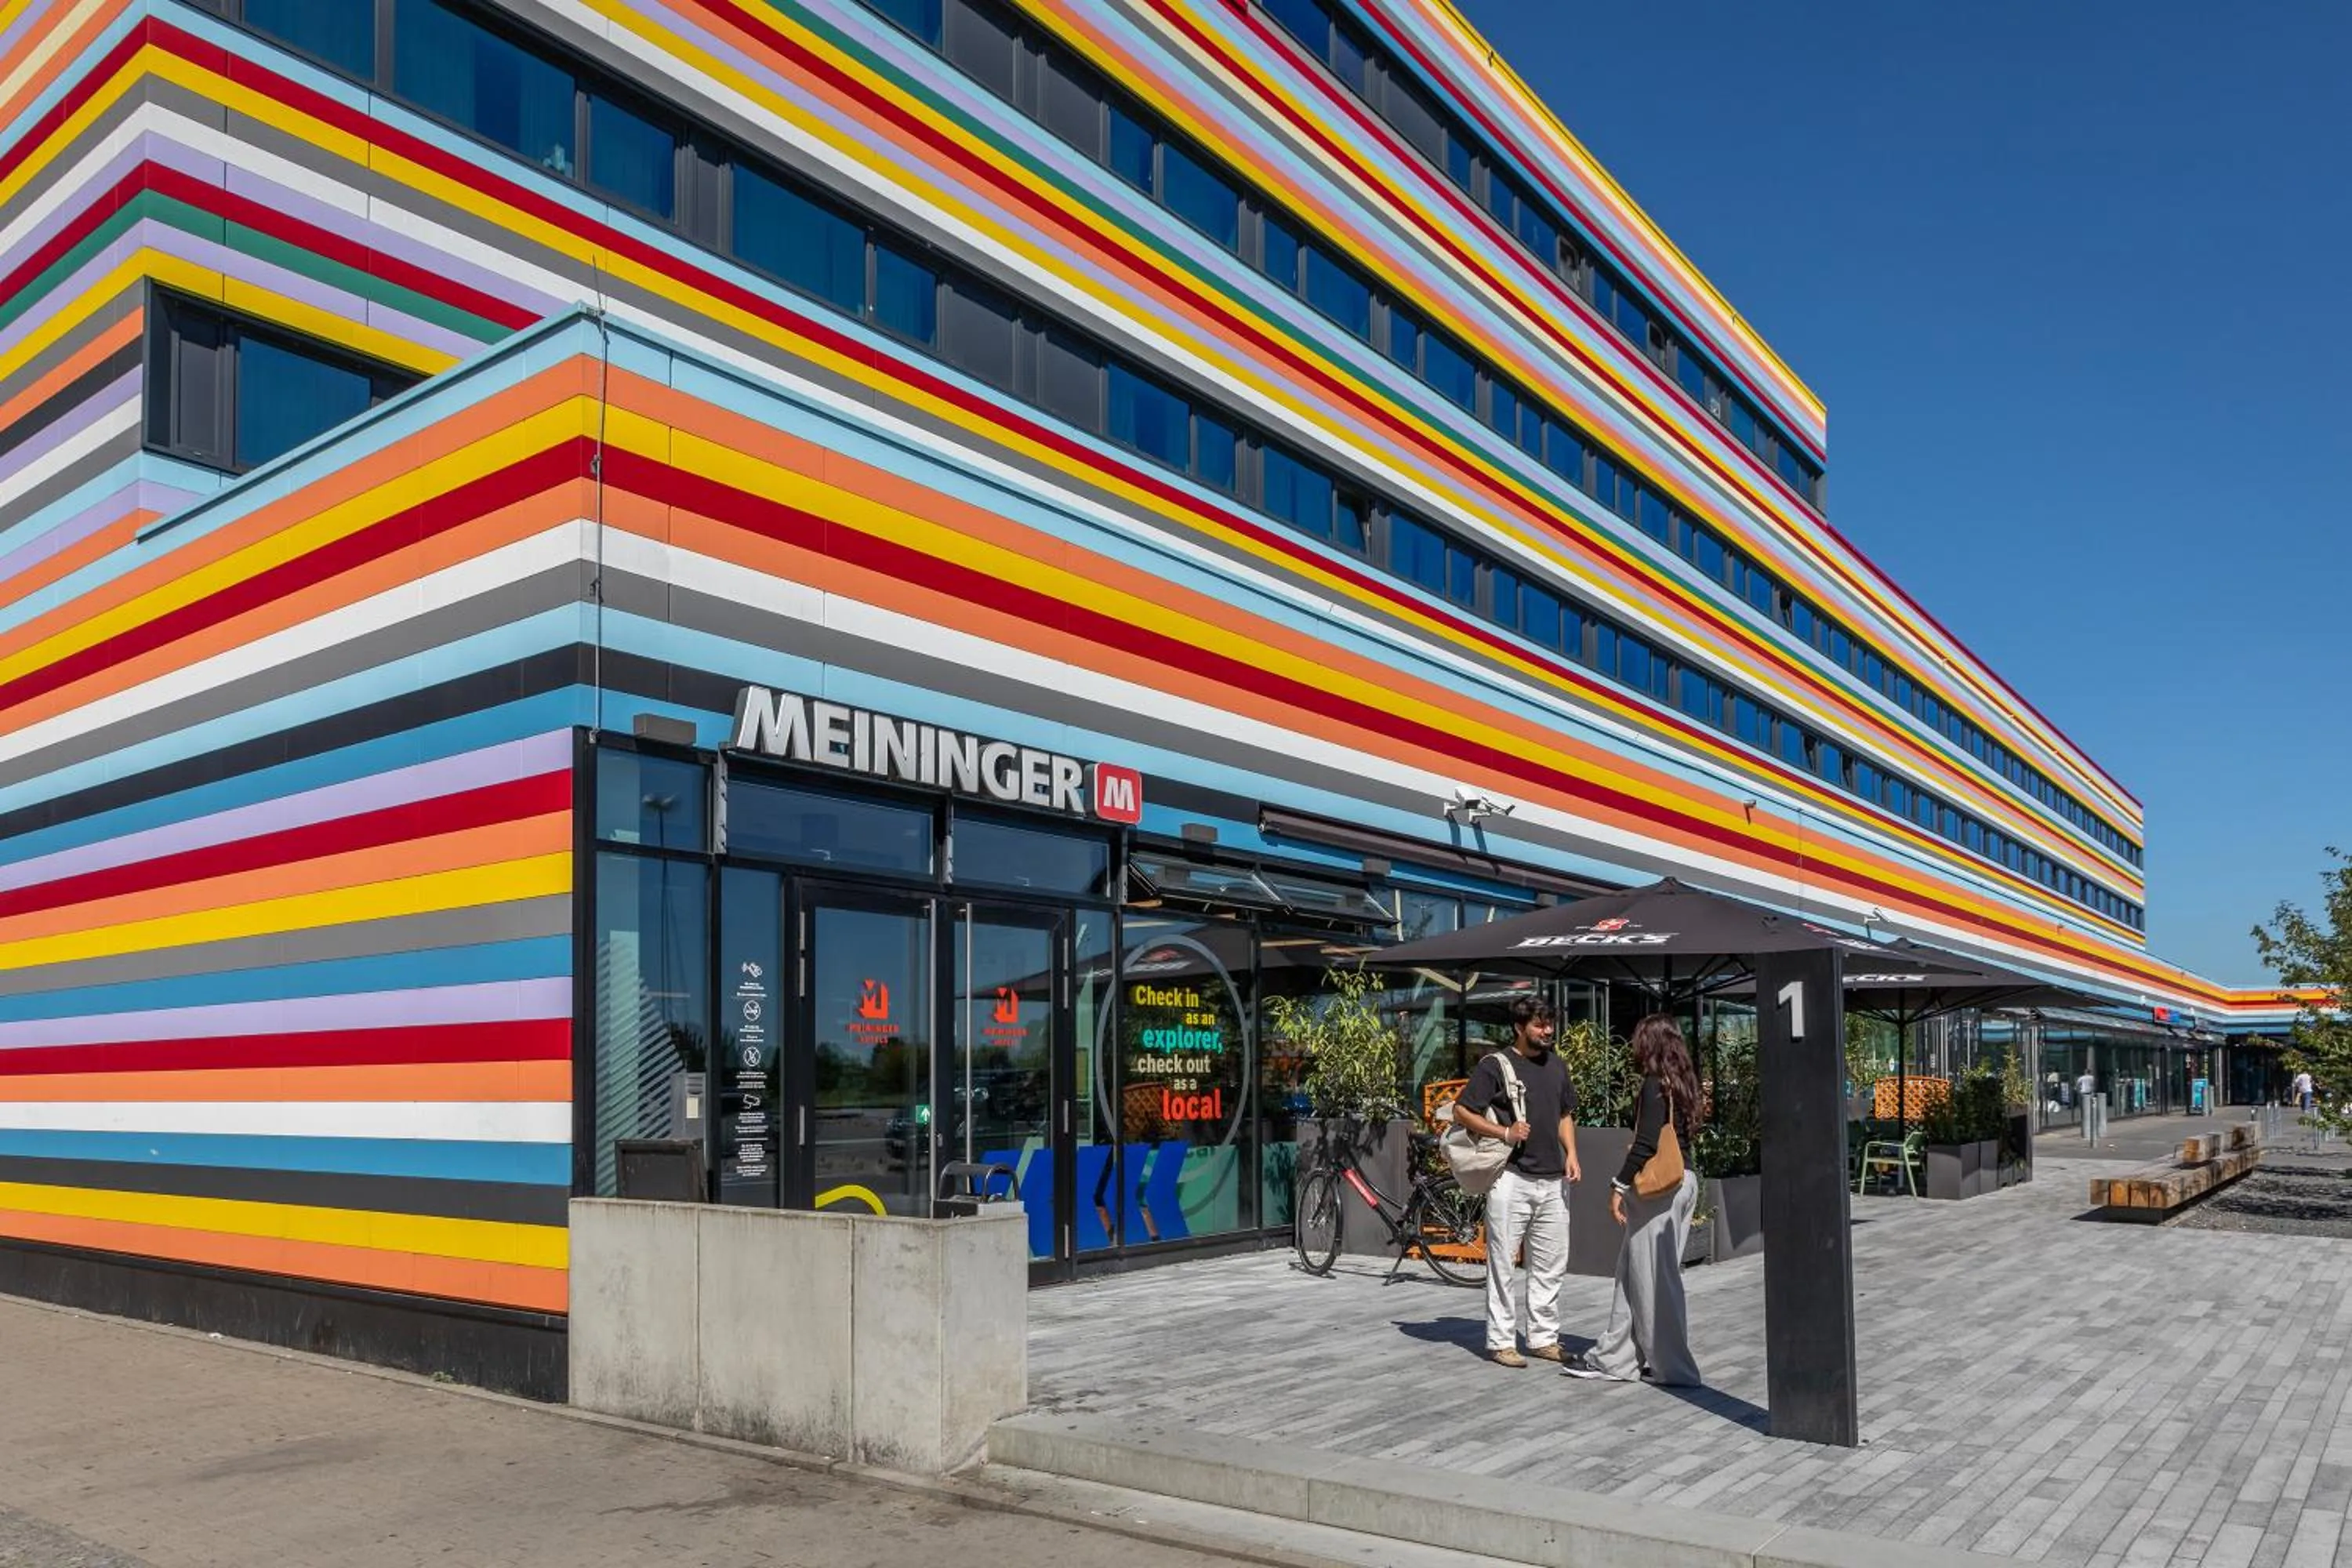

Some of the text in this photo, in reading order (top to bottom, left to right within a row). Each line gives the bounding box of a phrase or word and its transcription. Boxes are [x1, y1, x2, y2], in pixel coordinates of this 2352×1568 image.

[733, 684, 1136, 814] MEININGER M
[1135, 985, 1200, 1008] Check in
[1777, 980, 1806, 1037] 1
[1185, 1013, 1215, 1026] as an
[1142, 1025, 1224, 1054] explorer,
[1138, 1054, 1211, 1073] check out
[1174, 1079, 1197, 1091] as a
[1161, 1087, 1222, 1121] local
